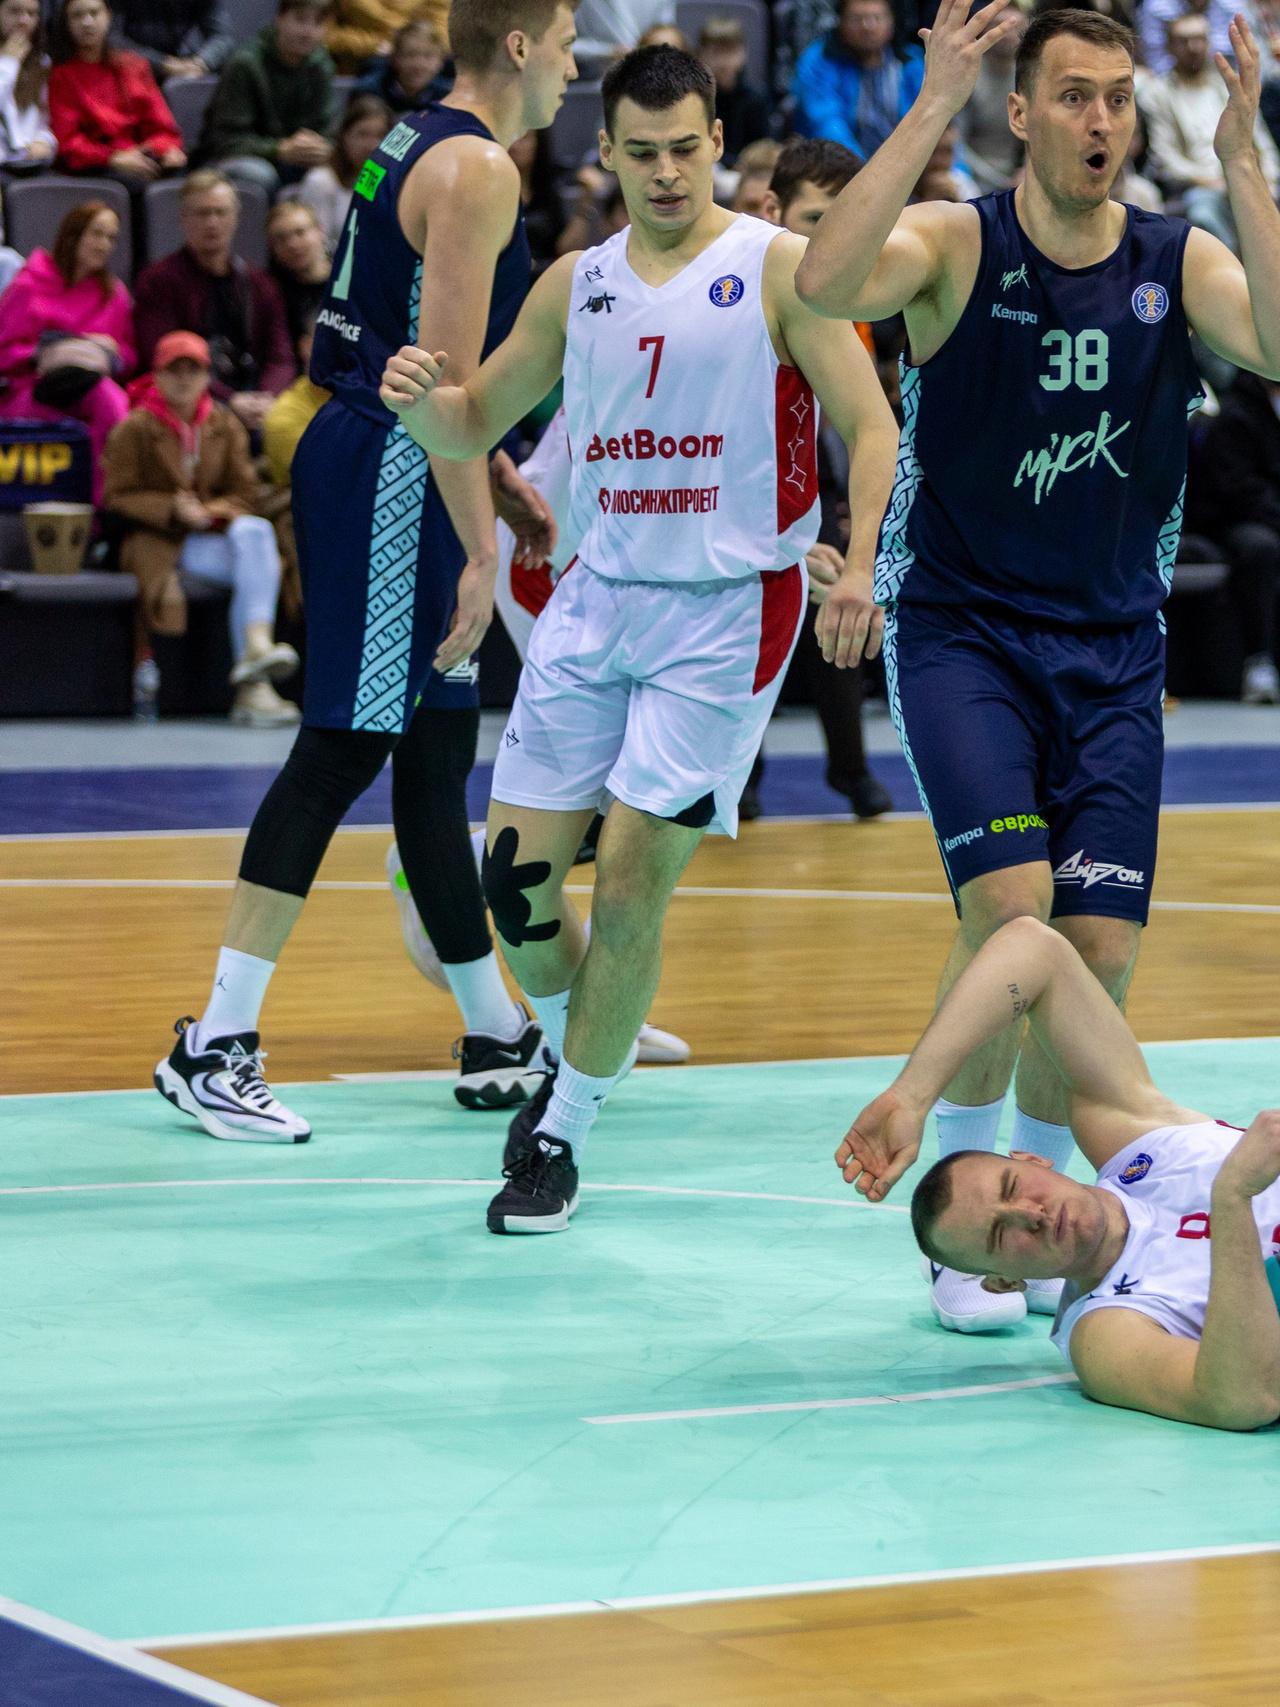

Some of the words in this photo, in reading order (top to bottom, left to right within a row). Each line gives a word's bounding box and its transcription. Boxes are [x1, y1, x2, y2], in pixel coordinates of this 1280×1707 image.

[991, 303, 1038, 325] Kempa
[638, 335, 665, 399] 7
[1039, 329, 1109, 391] 38
[0, 442, 72, 485] VIP
[586, 429, 723, 462] BetBoom
[944, 827, 984, 852] Kempa
